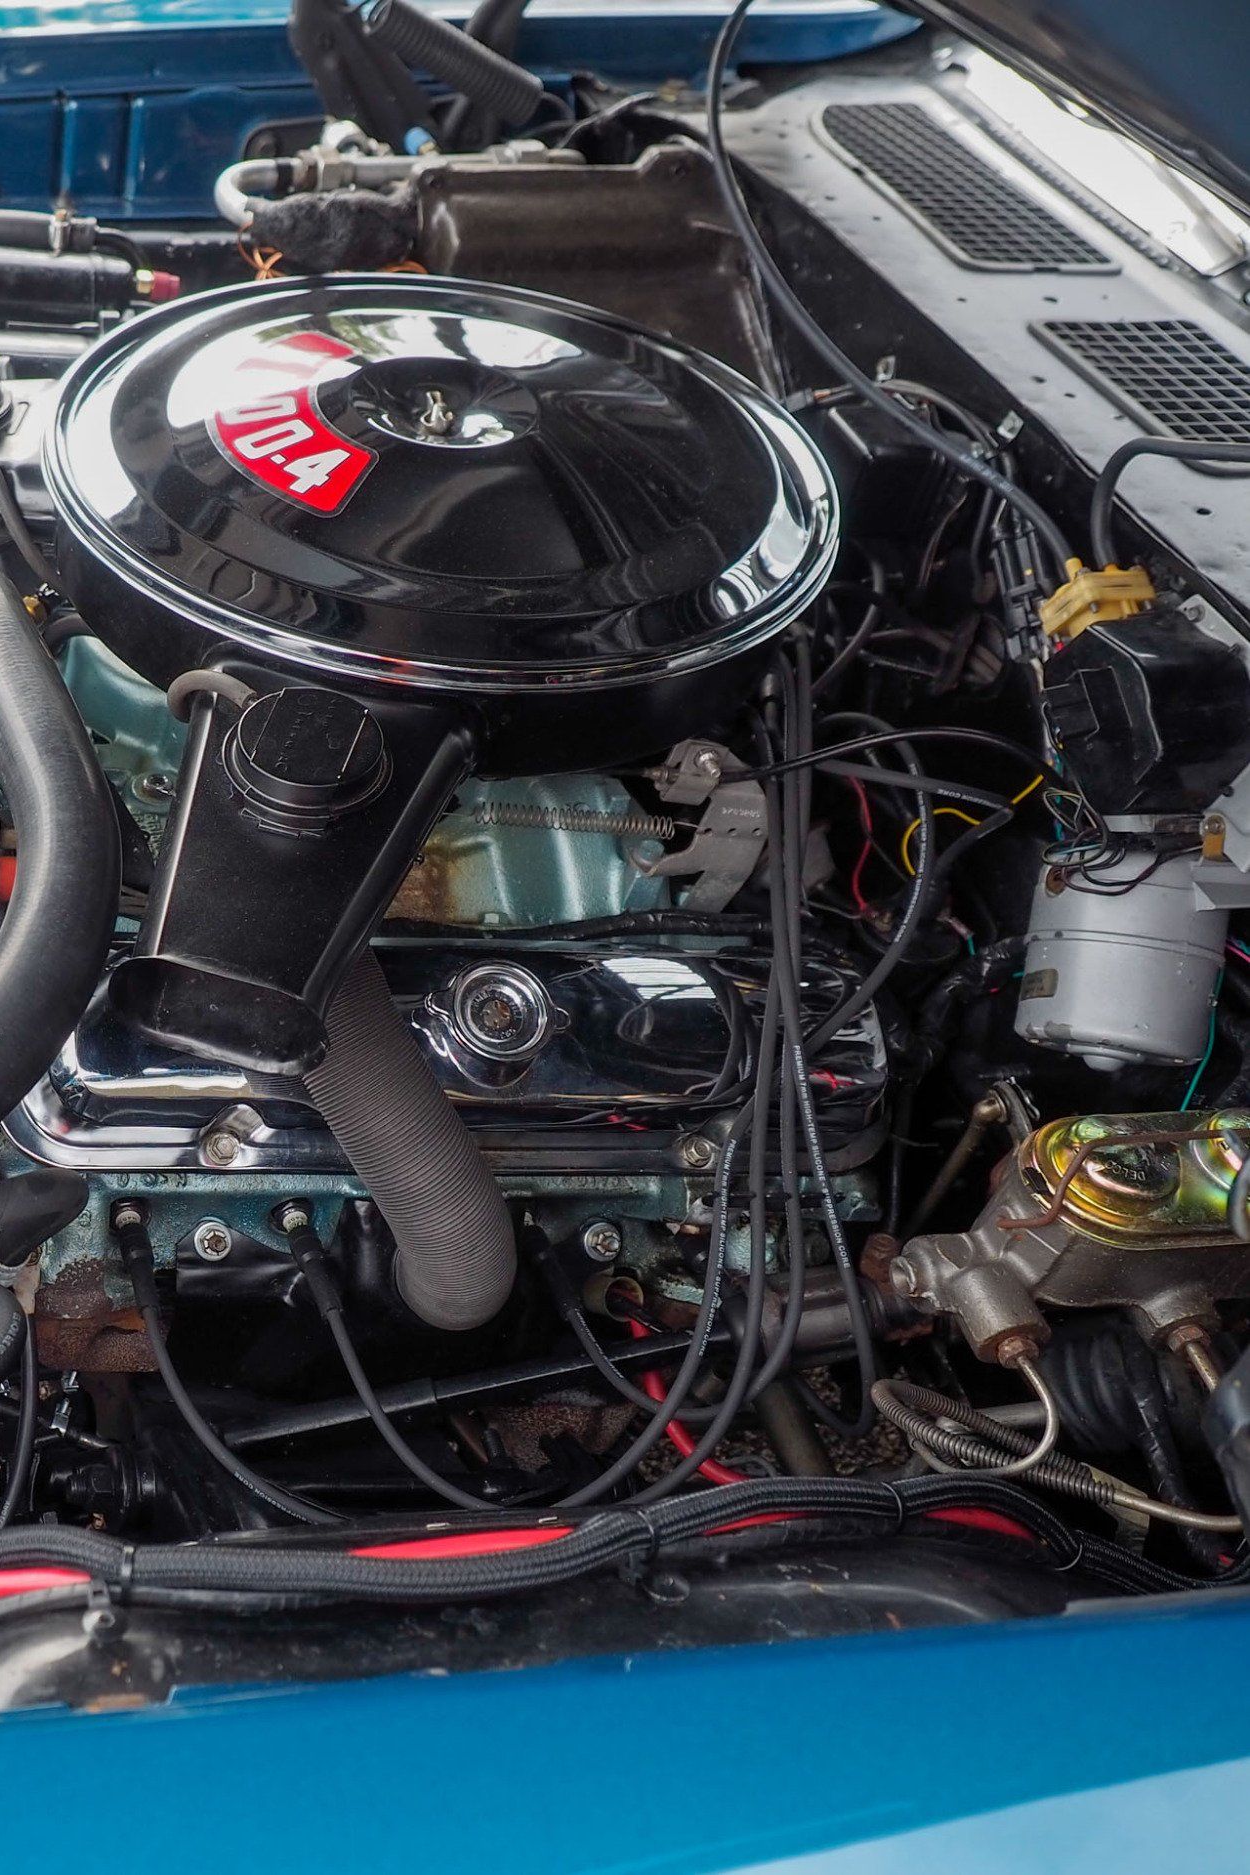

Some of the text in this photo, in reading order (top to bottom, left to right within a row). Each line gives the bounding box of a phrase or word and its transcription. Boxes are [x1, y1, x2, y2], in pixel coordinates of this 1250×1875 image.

[221, 370, 352, 494] 00-4
[793, 1045, 806, 1080] PREMIUM
[804, 1100, 817, 1143] HIGH-TEMP
[724, 1139, 737, 1170] PREMIUM
[810, 1144, 826, 1182] SILICONE
[1105, 1160, 1146, 1181] DELCO
[822, 1188, 843, 1244] SUPPRESSION
[717, 1233, 726, 1269] SILICONE
[838, 1245, 851, 1269] CORE
[706, 1276, 722, 1333] SUPPRESSION
[698, 1334, 710, 1357] CORE
